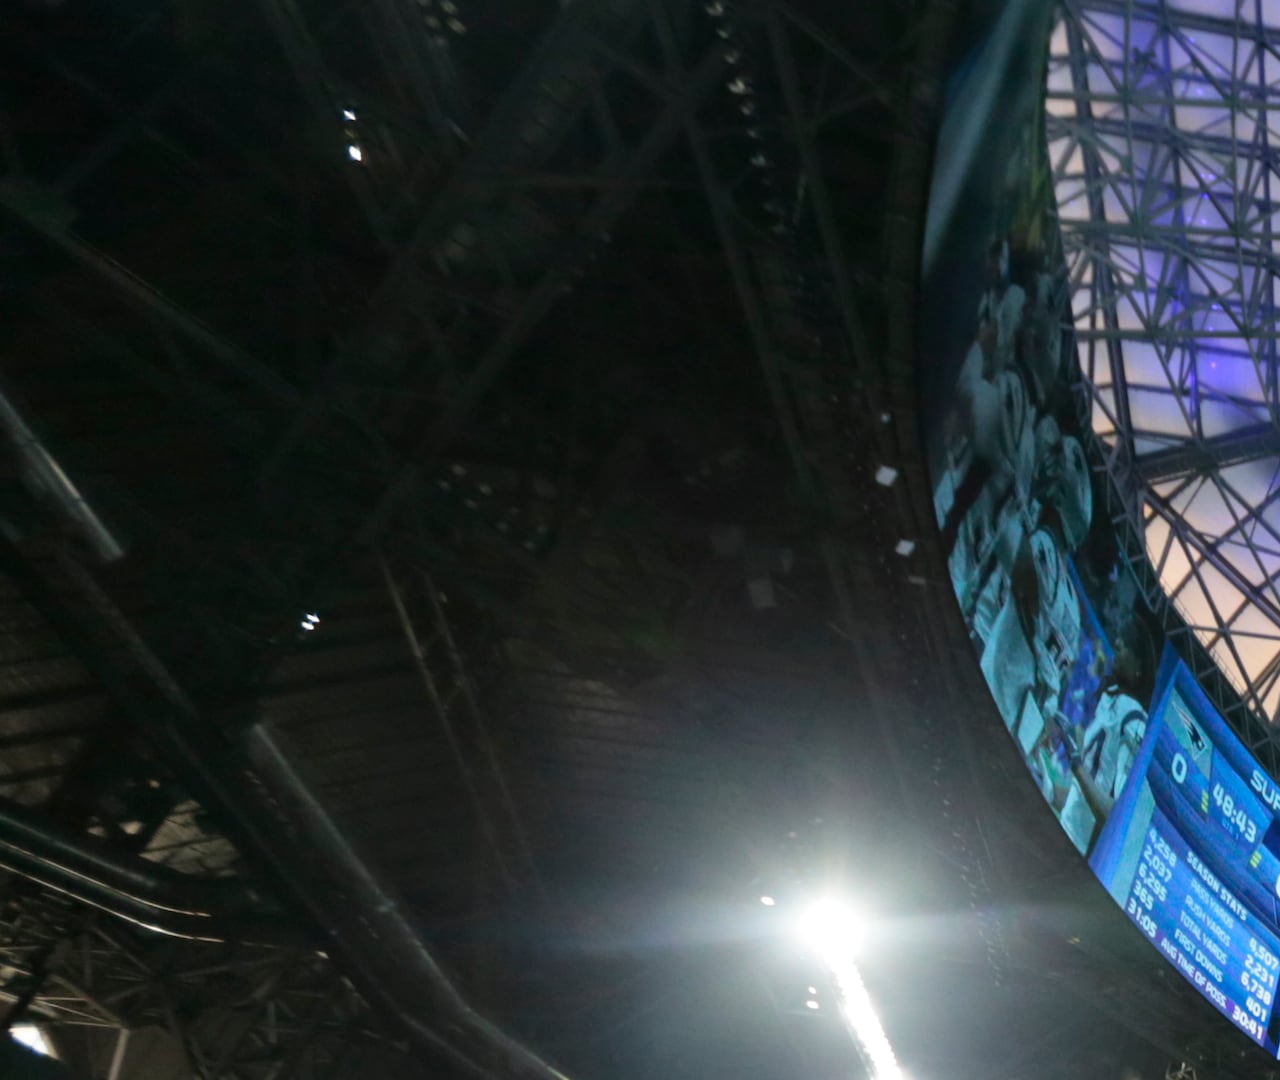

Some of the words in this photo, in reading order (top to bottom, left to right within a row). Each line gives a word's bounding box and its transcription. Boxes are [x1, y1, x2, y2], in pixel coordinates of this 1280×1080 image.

[1171, 753, 1187, 784] 0
[1213, 783, 1256, 843] 48:43
[1138, 864, 1167, 902] 6,295
[1180, 910, 1202, 941] TOTAL
[1240, 971, 1272, 1006] 6,738
[1144, 845, 1172, 882] 2,037
[1244, 954, 1275, 987] 2,231
[1187, 852, 1219, 892] SEASON
[1220, 886, 1248, 921] STATS
[1128, 898, 1158, 938] 31:05
[1160, 938, 1178, 960] AVG
[1178, 952, 1195, 978] TIME
[1194, 970, 1206, 986] OF
[1232, 1004, 1264, 1040] 30:41
[1133, 880, 1154, 911] 365
[1174, 928, 1197, 956] FIRST
[1195, 948, 1224, 983] DOWNS
[1246, 996, 1266, 1022] 401
[1249, 937, 1280, 970] 4,507
